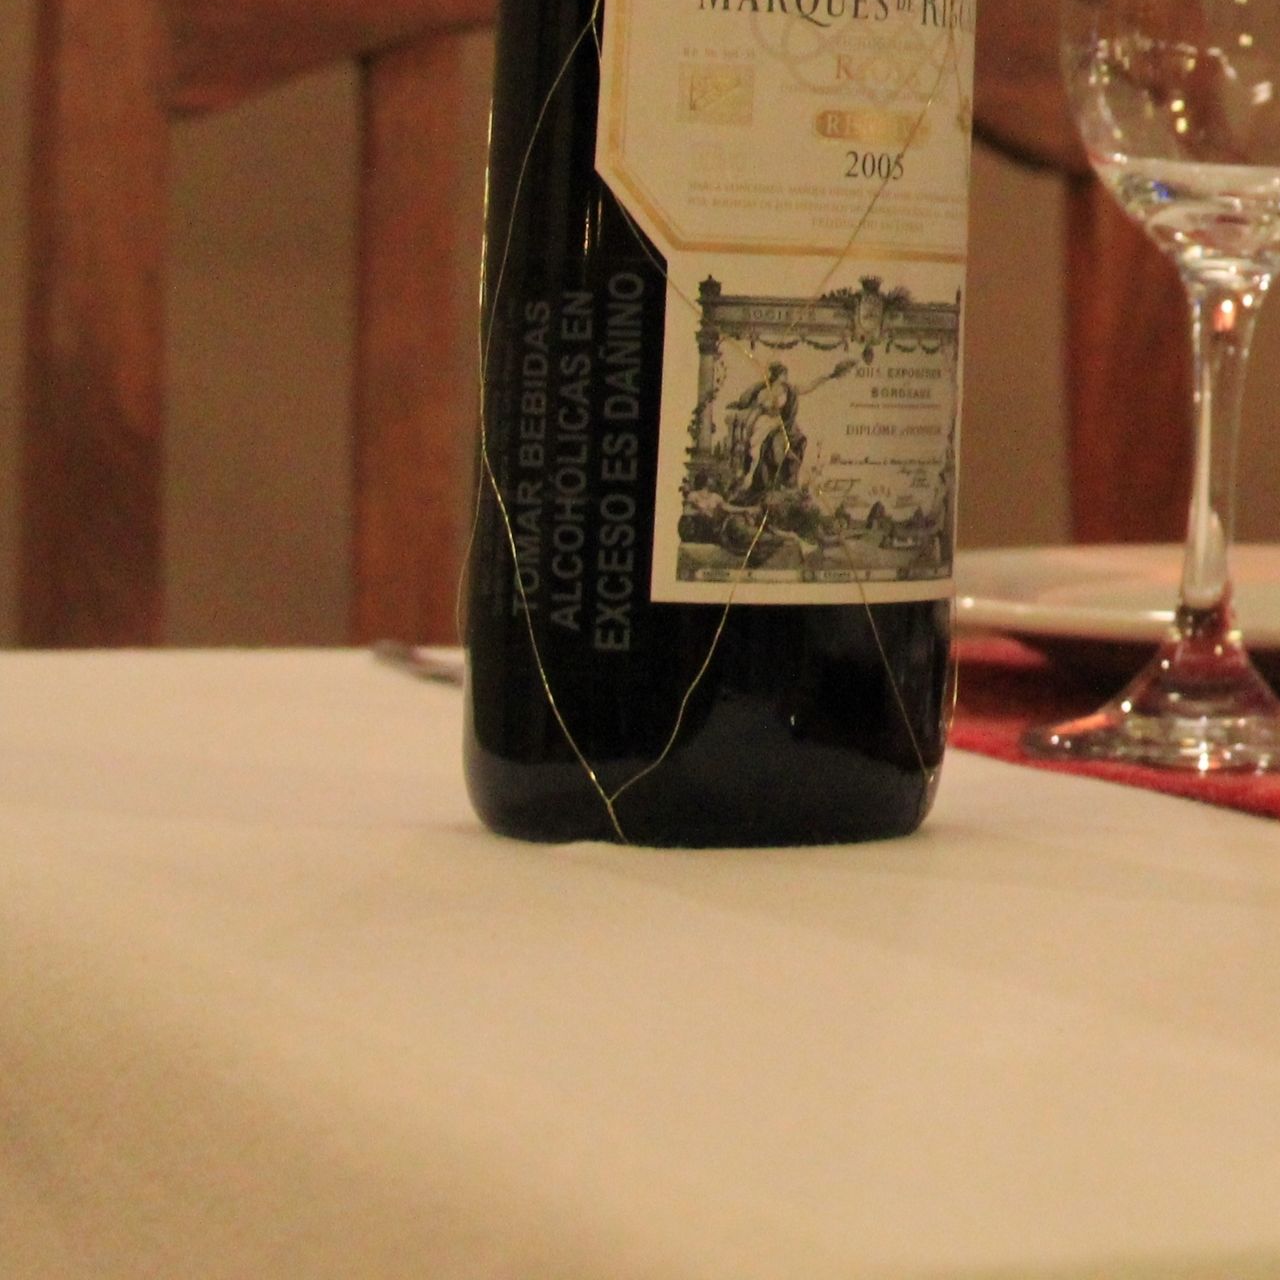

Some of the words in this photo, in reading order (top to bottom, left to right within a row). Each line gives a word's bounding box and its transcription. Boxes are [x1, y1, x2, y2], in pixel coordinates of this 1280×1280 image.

[844, 150, 905, 180] 2005
[520, 301, 550, 468] BEBIDAS
[562, 291, 593, 340] EN
[600, 271, 645, 421] DAÑINO
[550, 355, 592, 631] ALCOHÓLICAS
[602, 431, 639, 482] ES
[512, 480, 544, 617] TOMAR
[594, 492, 636, 652] EXCESO
